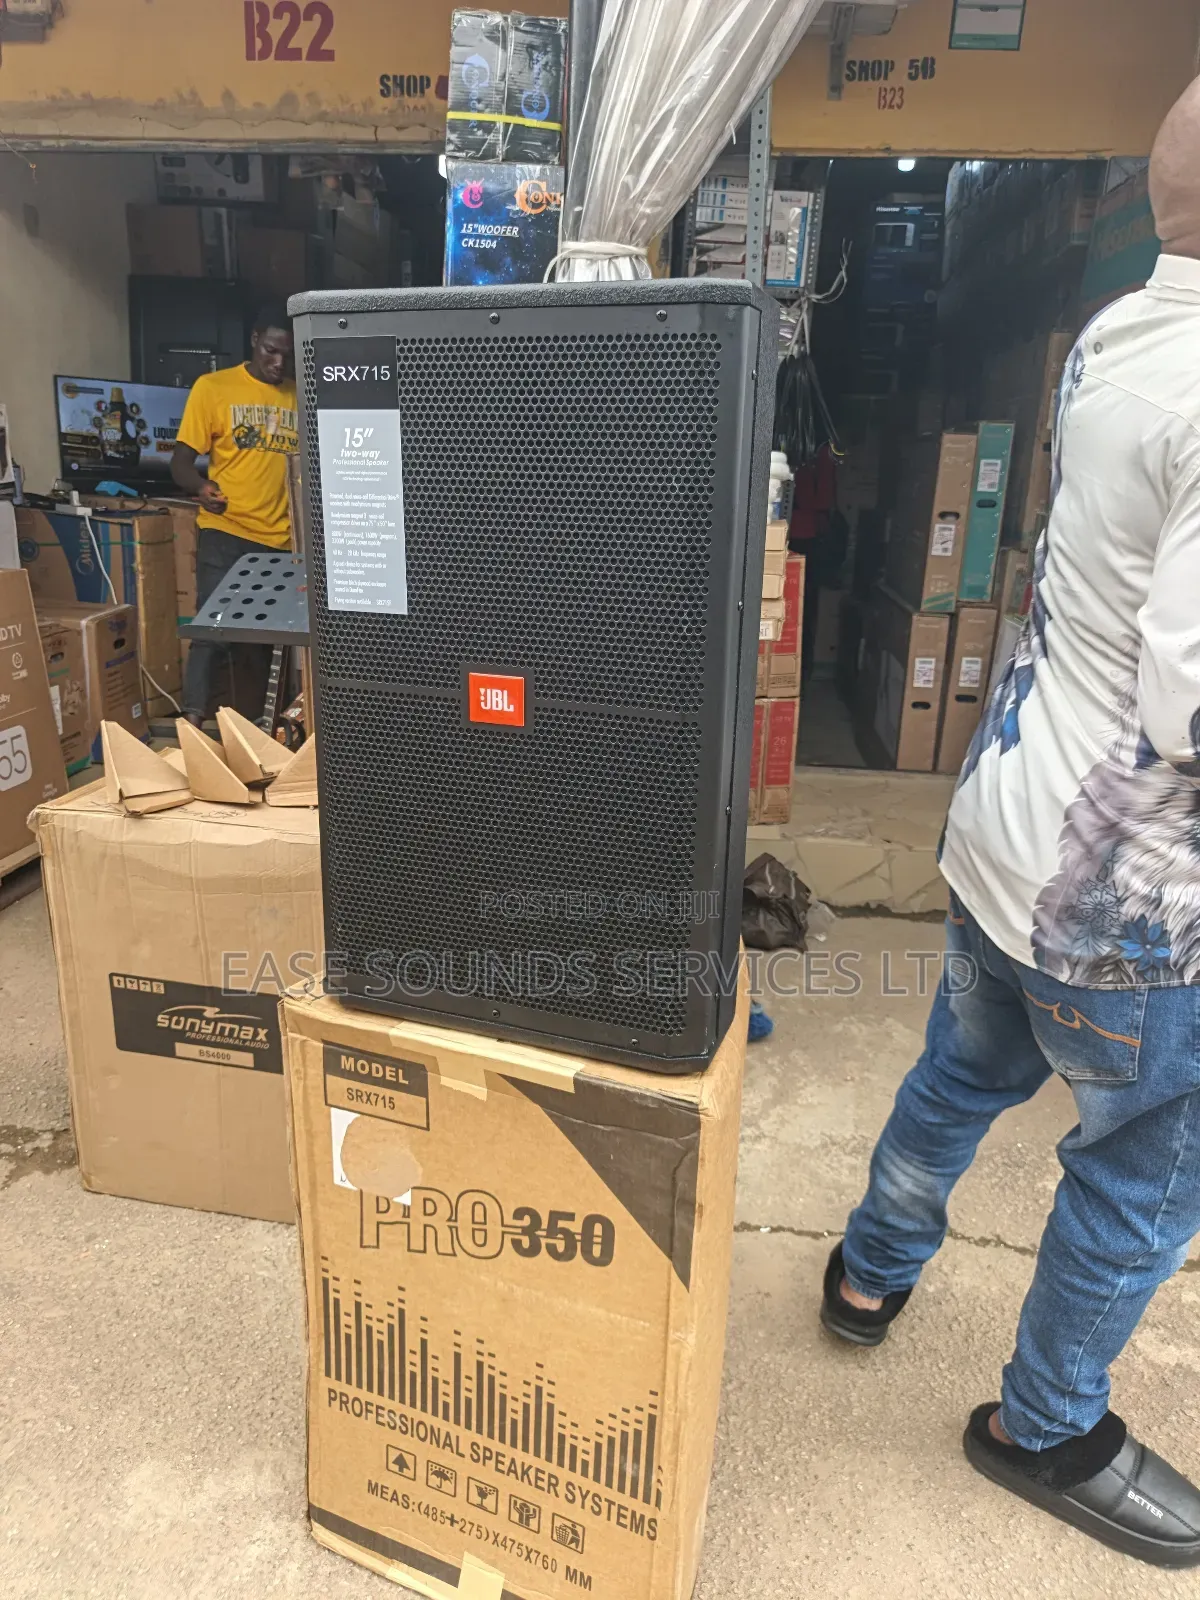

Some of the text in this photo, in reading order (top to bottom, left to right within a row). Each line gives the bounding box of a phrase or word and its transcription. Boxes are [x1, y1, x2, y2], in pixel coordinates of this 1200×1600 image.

[244, 1, 336, 62] B22
[846, 60, 895, 82] SHOP
[379, 74, 431, 98] SHOP
[877, 86, 905, 110] B23
[461, 238, 498, 249] CK1504
[322, 365, 391, 382] SRX715
[344, 427, 374, 448] 15"
[340, 448, 381, 460] two-way
[479, 687, 515, 712] JBL
[185, 1031, 270, 1050] PROFESSIONAL AUDIO
[198, 1049, 231, 1061] BS4000
[340, 1054, 409, 1085] MODEL
[346, 1087, 396, 1111] SRX715
[510, 1205, 616, 1267] 350
[327, 1387, 658, 1541] PROFESSIONAL SPEAKER SYSTEMS
[1127, 1490, 1164, 1520] BETTER
[564, 1564, 593, 1592] MM
